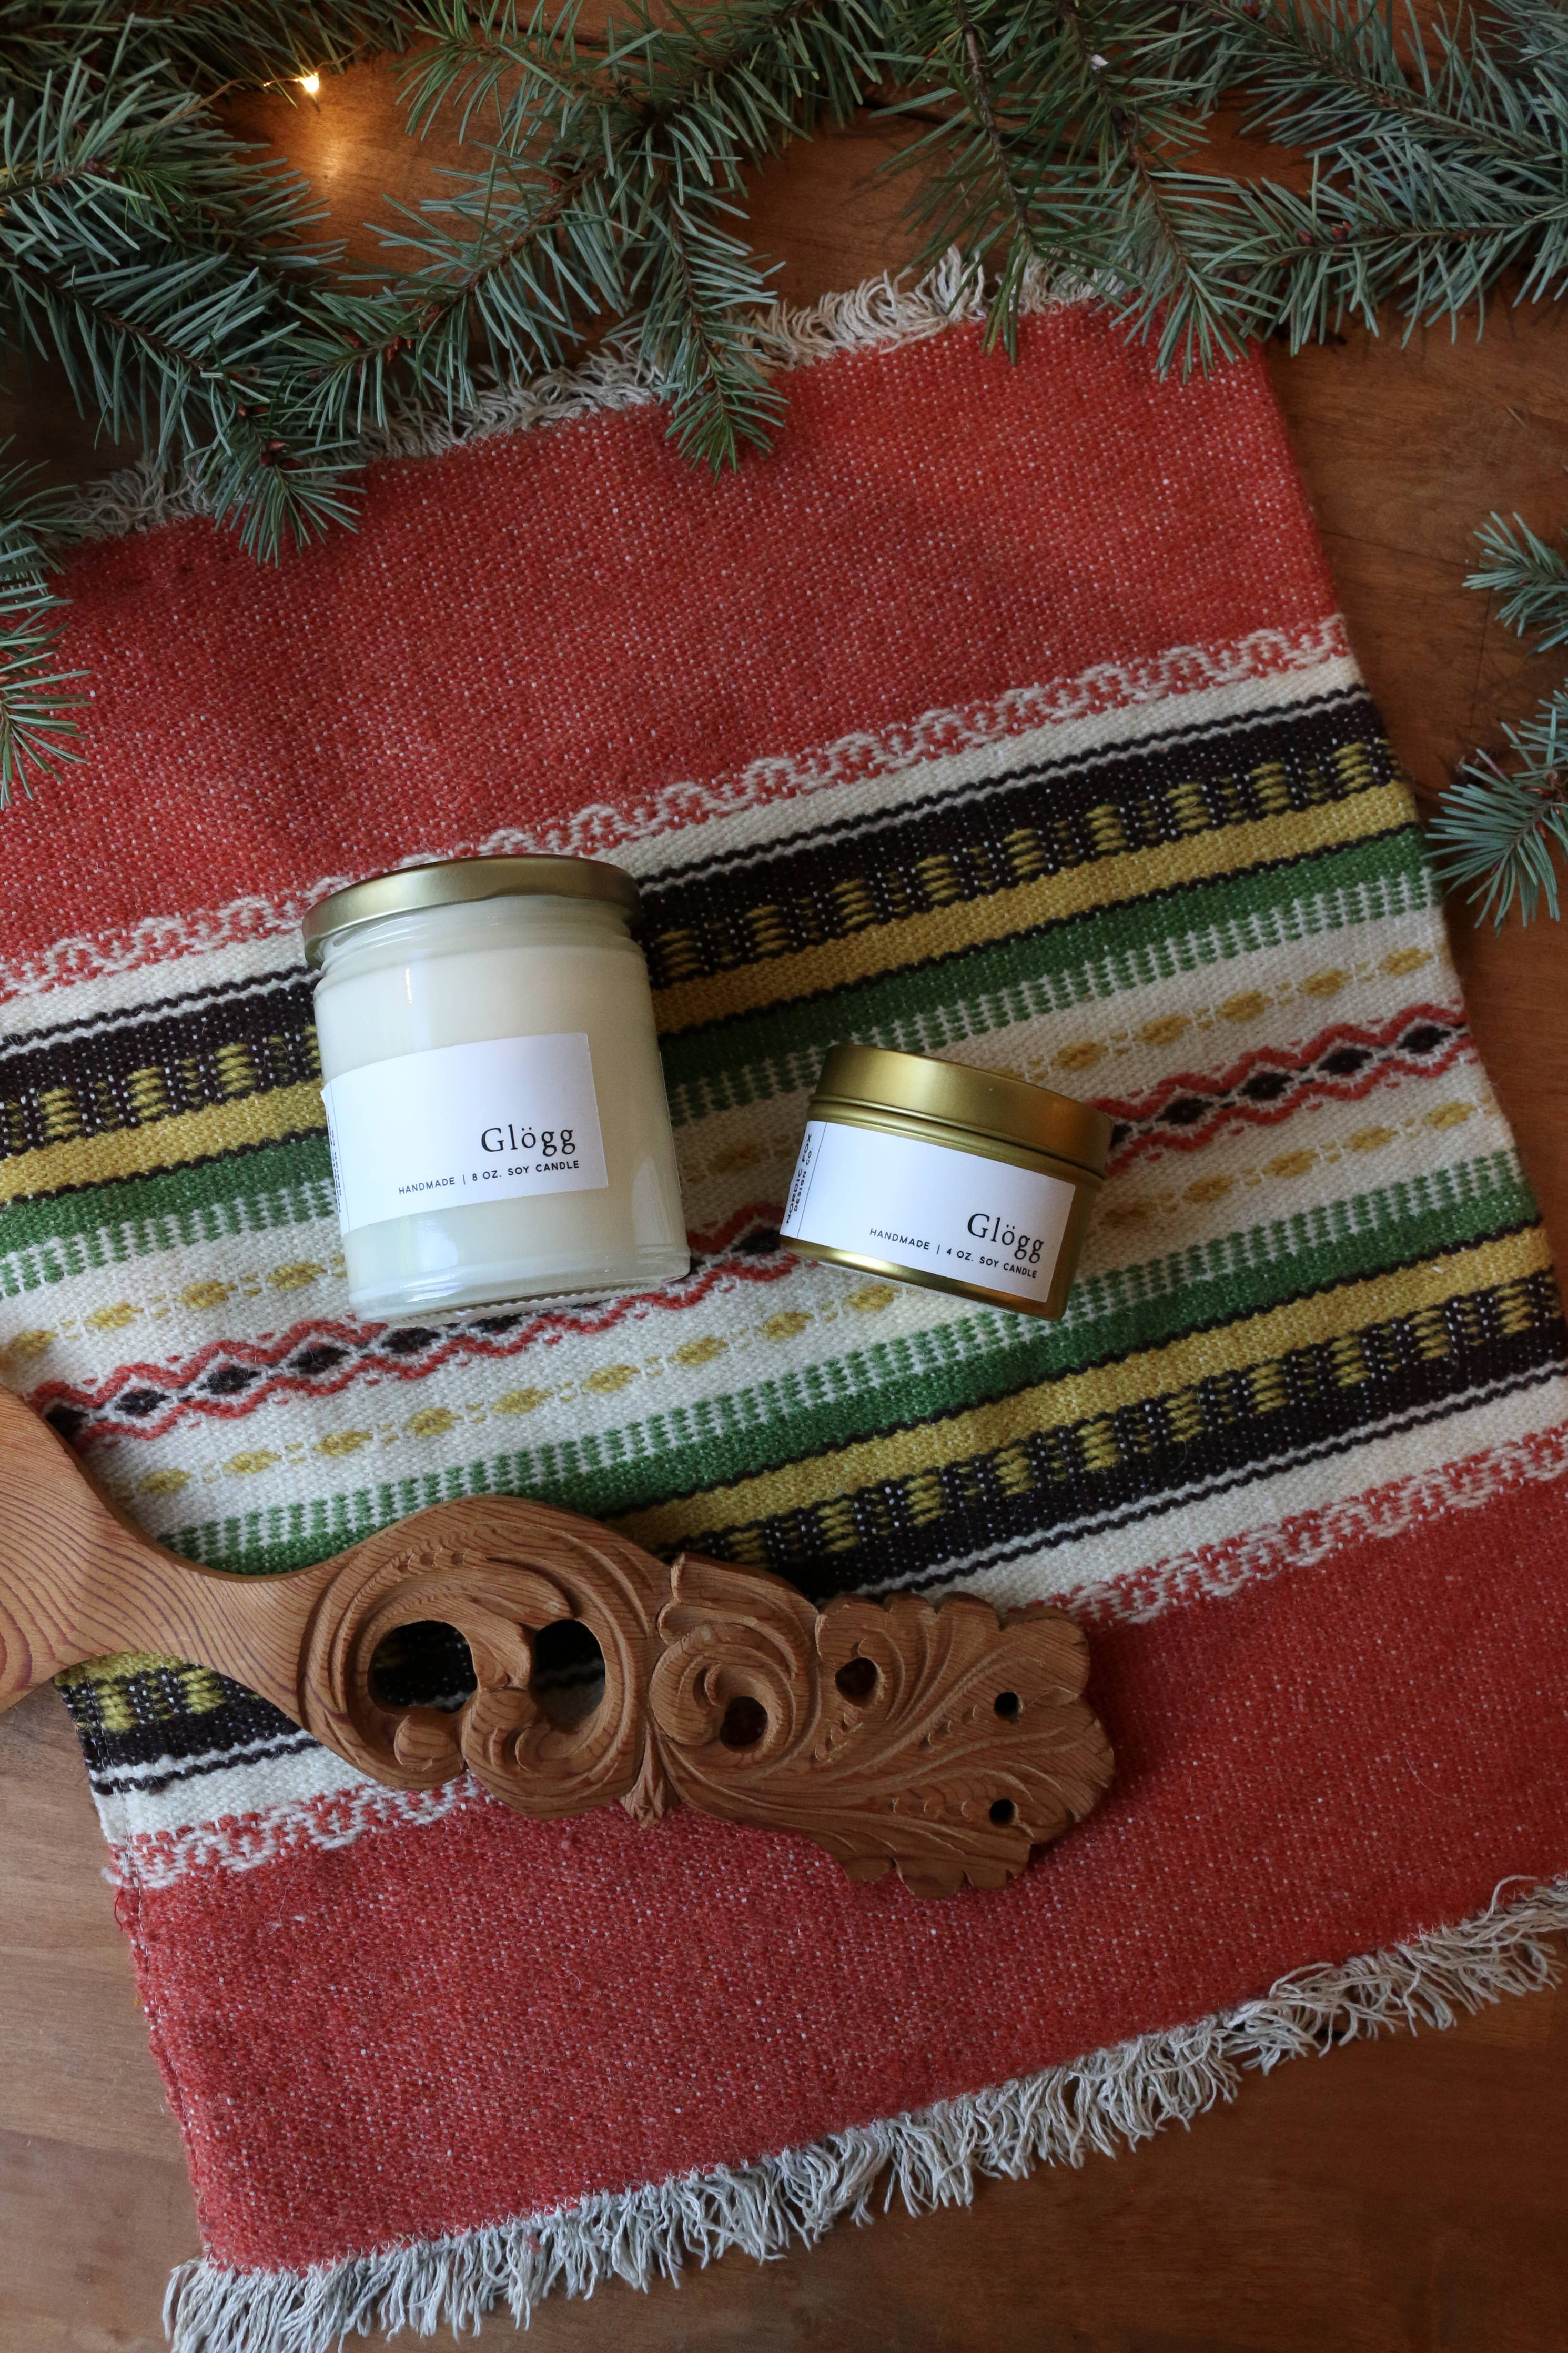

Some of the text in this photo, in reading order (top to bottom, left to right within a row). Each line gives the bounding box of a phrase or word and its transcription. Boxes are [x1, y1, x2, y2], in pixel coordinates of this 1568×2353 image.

[481, 1124, 576, 1157] Glögg
[399, 1177, 456, 1195] HANDMADE
[482, 1170, 502, 1180] OZ.
[508, 1166, 529, 1176] SOY
[535, 1160, 580, 1172] CANDLE
[786, 1133, 812, 1224] NORDIC FOX
[794, 1171, 807, 1212] DESIGN
[869, 1228, 930, 1250] HANDMADE
[956, 1250, 974, 1261] OZ.
[979, 1256, 999, 1268] SOY
[1003, 1263, 1038, 1279] CANDLE
[967, 1213, 1044, 1264] Glögg
